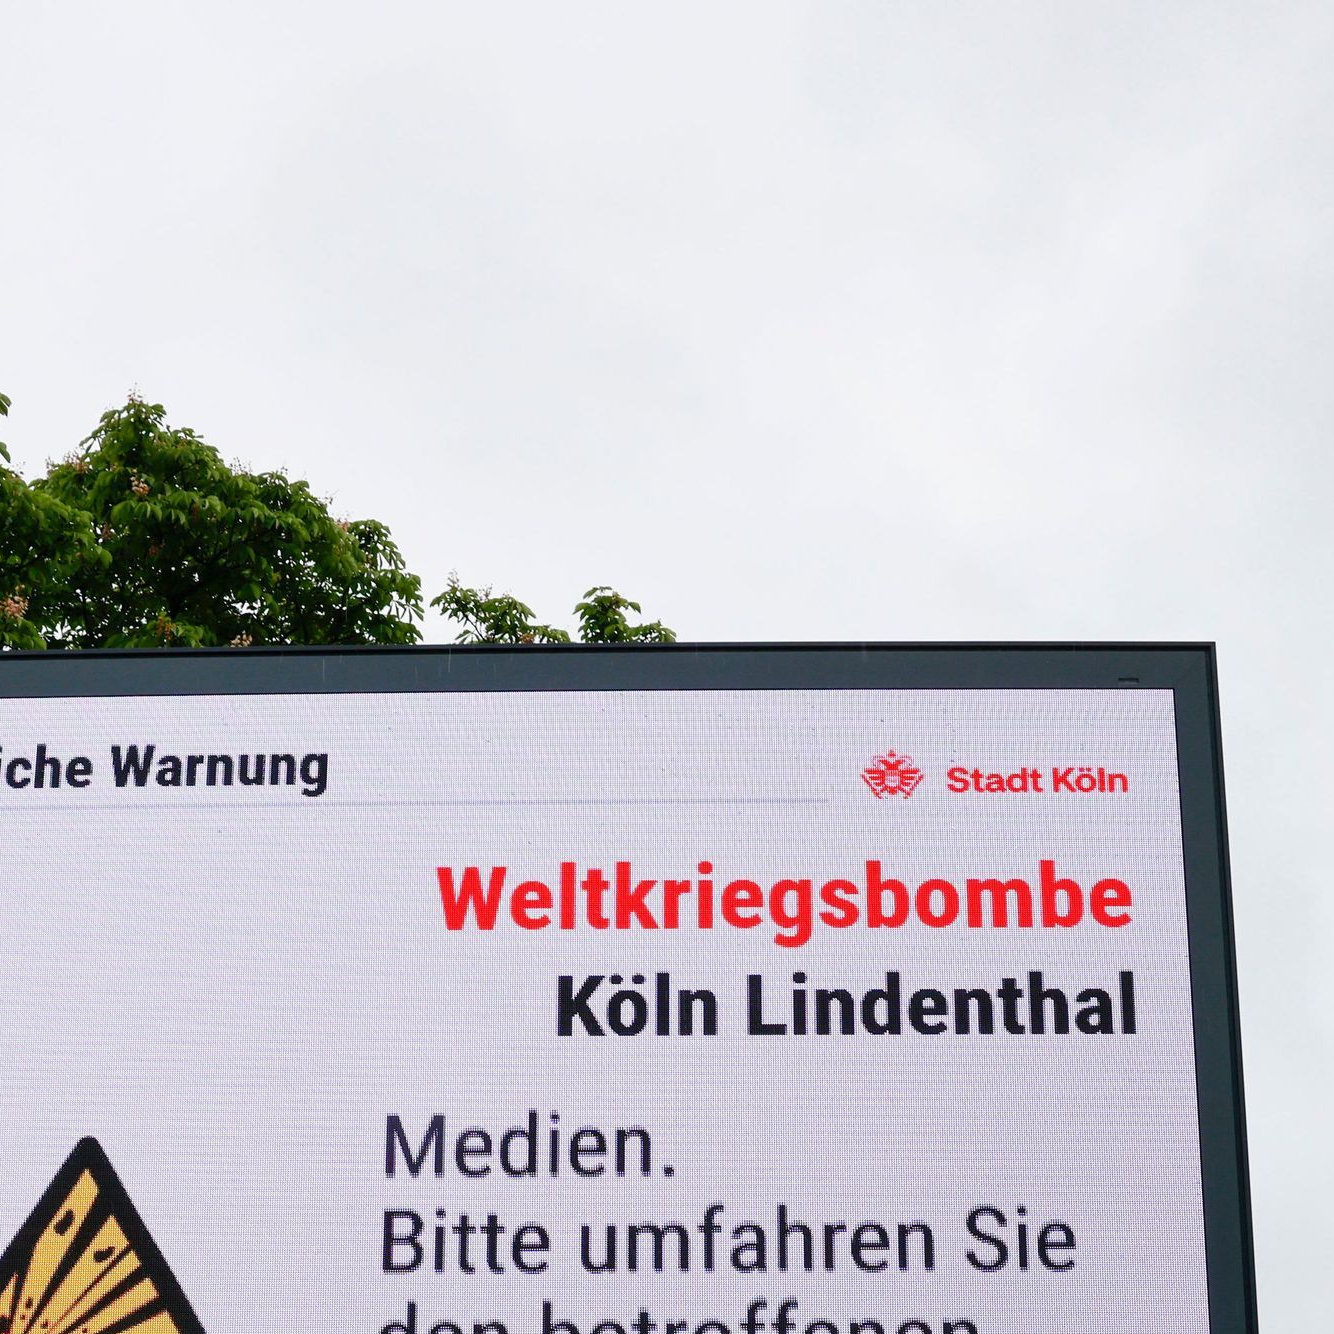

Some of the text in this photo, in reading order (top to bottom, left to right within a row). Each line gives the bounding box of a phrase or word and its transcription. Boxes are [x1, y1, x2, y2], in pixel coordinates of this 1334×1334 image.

[111, 745, 328, 797] Warnung
[947, 766, 1129, 793] Stadt Köln
[437, 860, 1132, 948] Weltkriegsbombe
[557, 969, 1137, 1037] Köln Lindenthal
[384, 1109, 675, 1178] Medien.
[382, 1203, 1077, 1274] Bitte umfahren Sie
